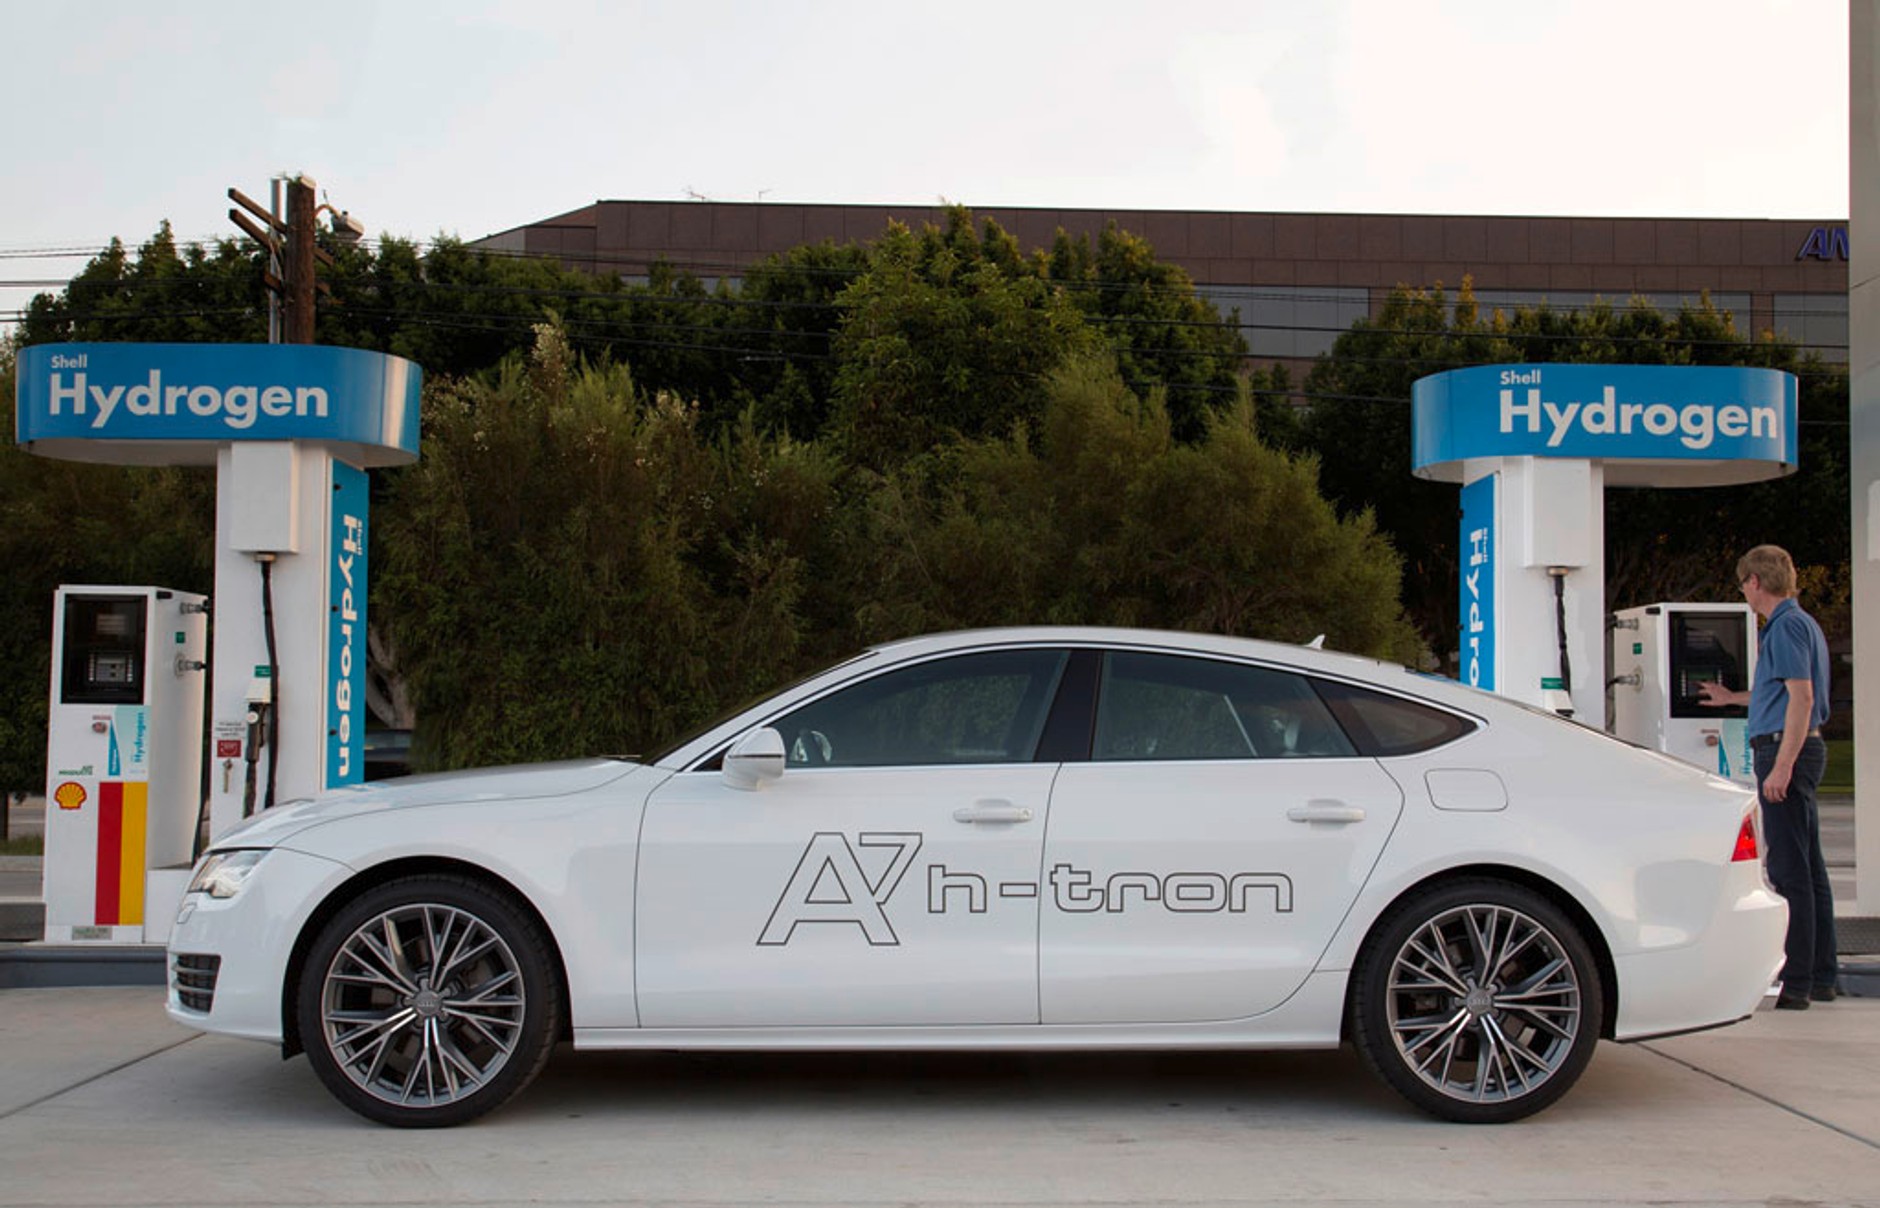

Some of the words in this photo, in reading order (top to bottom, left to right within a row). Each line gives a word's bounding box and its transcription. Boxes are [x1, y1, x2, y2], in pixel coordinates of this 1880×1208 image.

[51, 354, 87, 369] Shell
[1500, 369, 1542, 385] Shell
[49, 369, 328, 429] Hydrogen
[1499, 386, 1778, 450] Hydrogen
[336, 514, 358, 777] Hydrogen
[756, 832, 923, 946] A7
